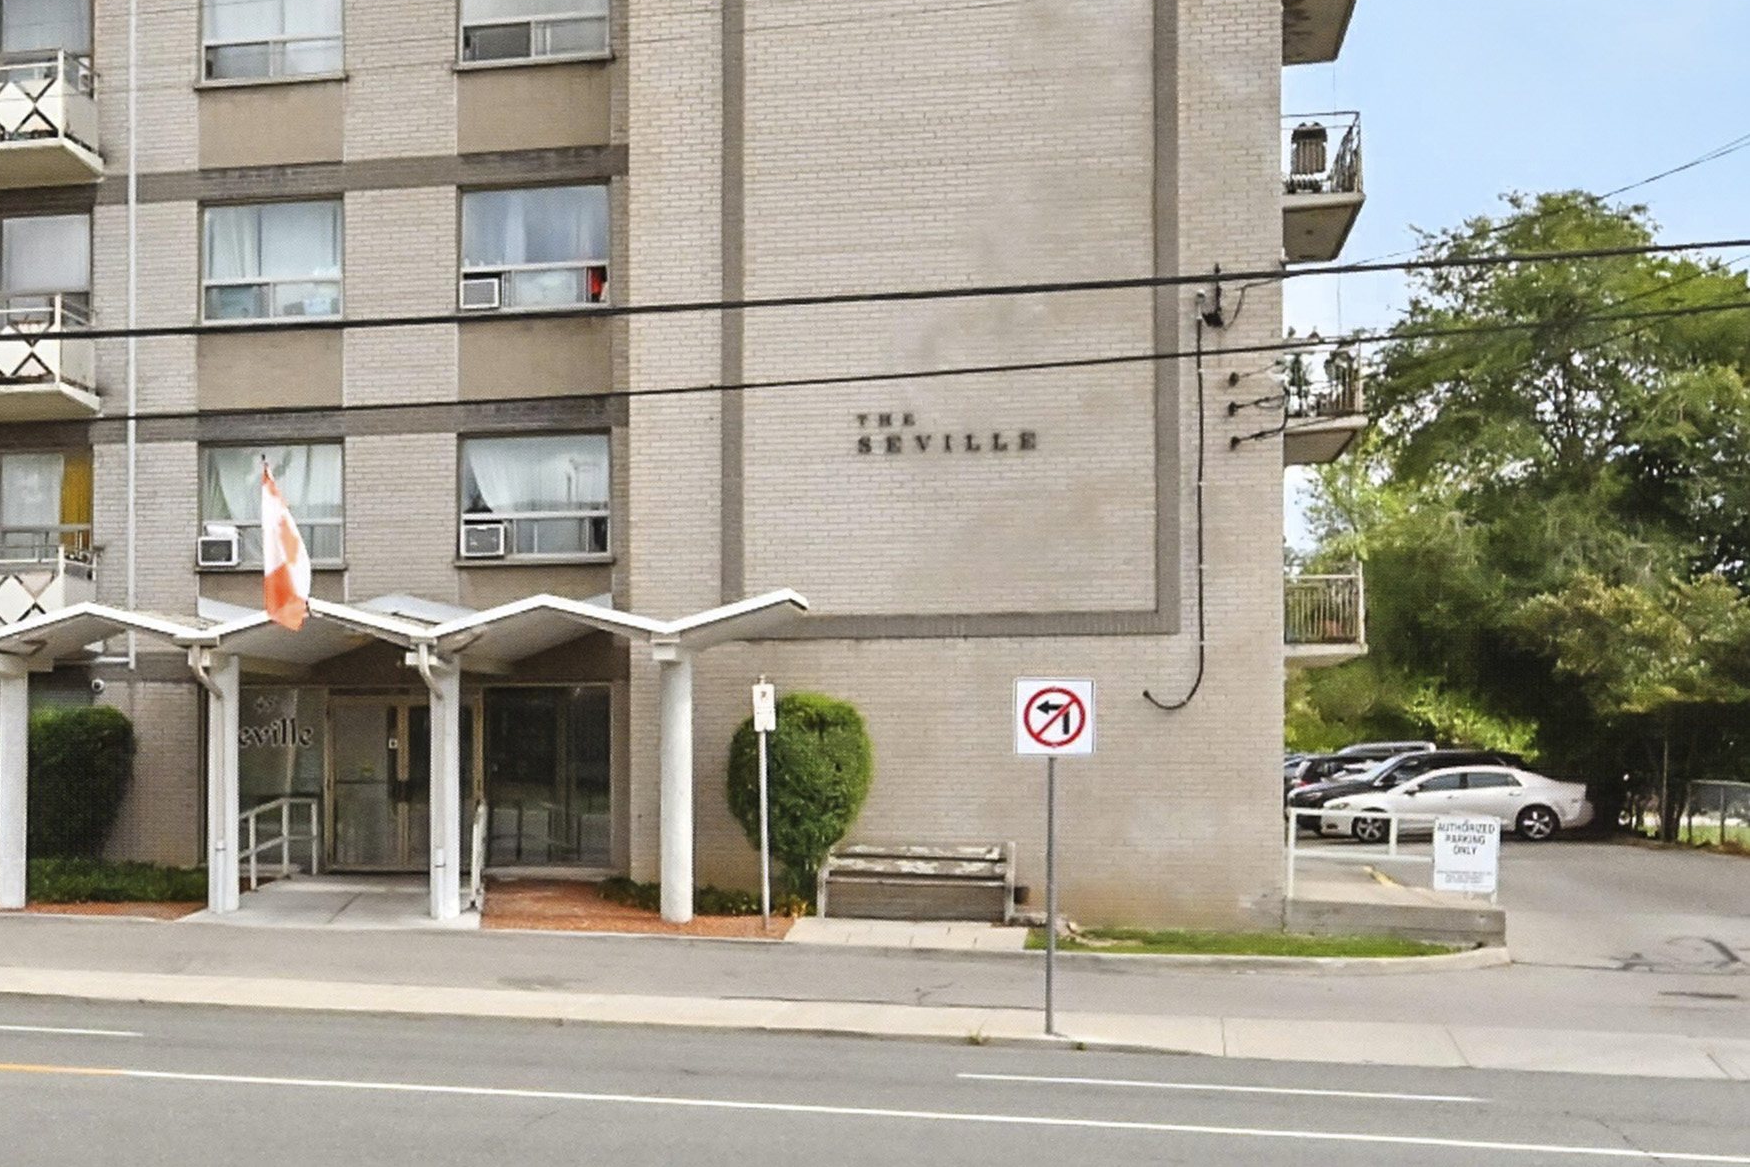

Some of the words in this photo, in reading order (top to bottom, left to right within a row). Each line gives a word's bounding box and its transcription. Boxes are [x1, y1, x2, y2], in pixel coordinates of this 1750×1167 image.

[857, 413, 917, 428] THE
[857, 431, 1037, 454] SEVILLE
[238, 717, 314, 748] eville
[1437, 822, 1496, 834] AUTHORIZED
[1445, 834, 1486, 845] PARKING
[1453, 844, 1478, 855] ONLY
